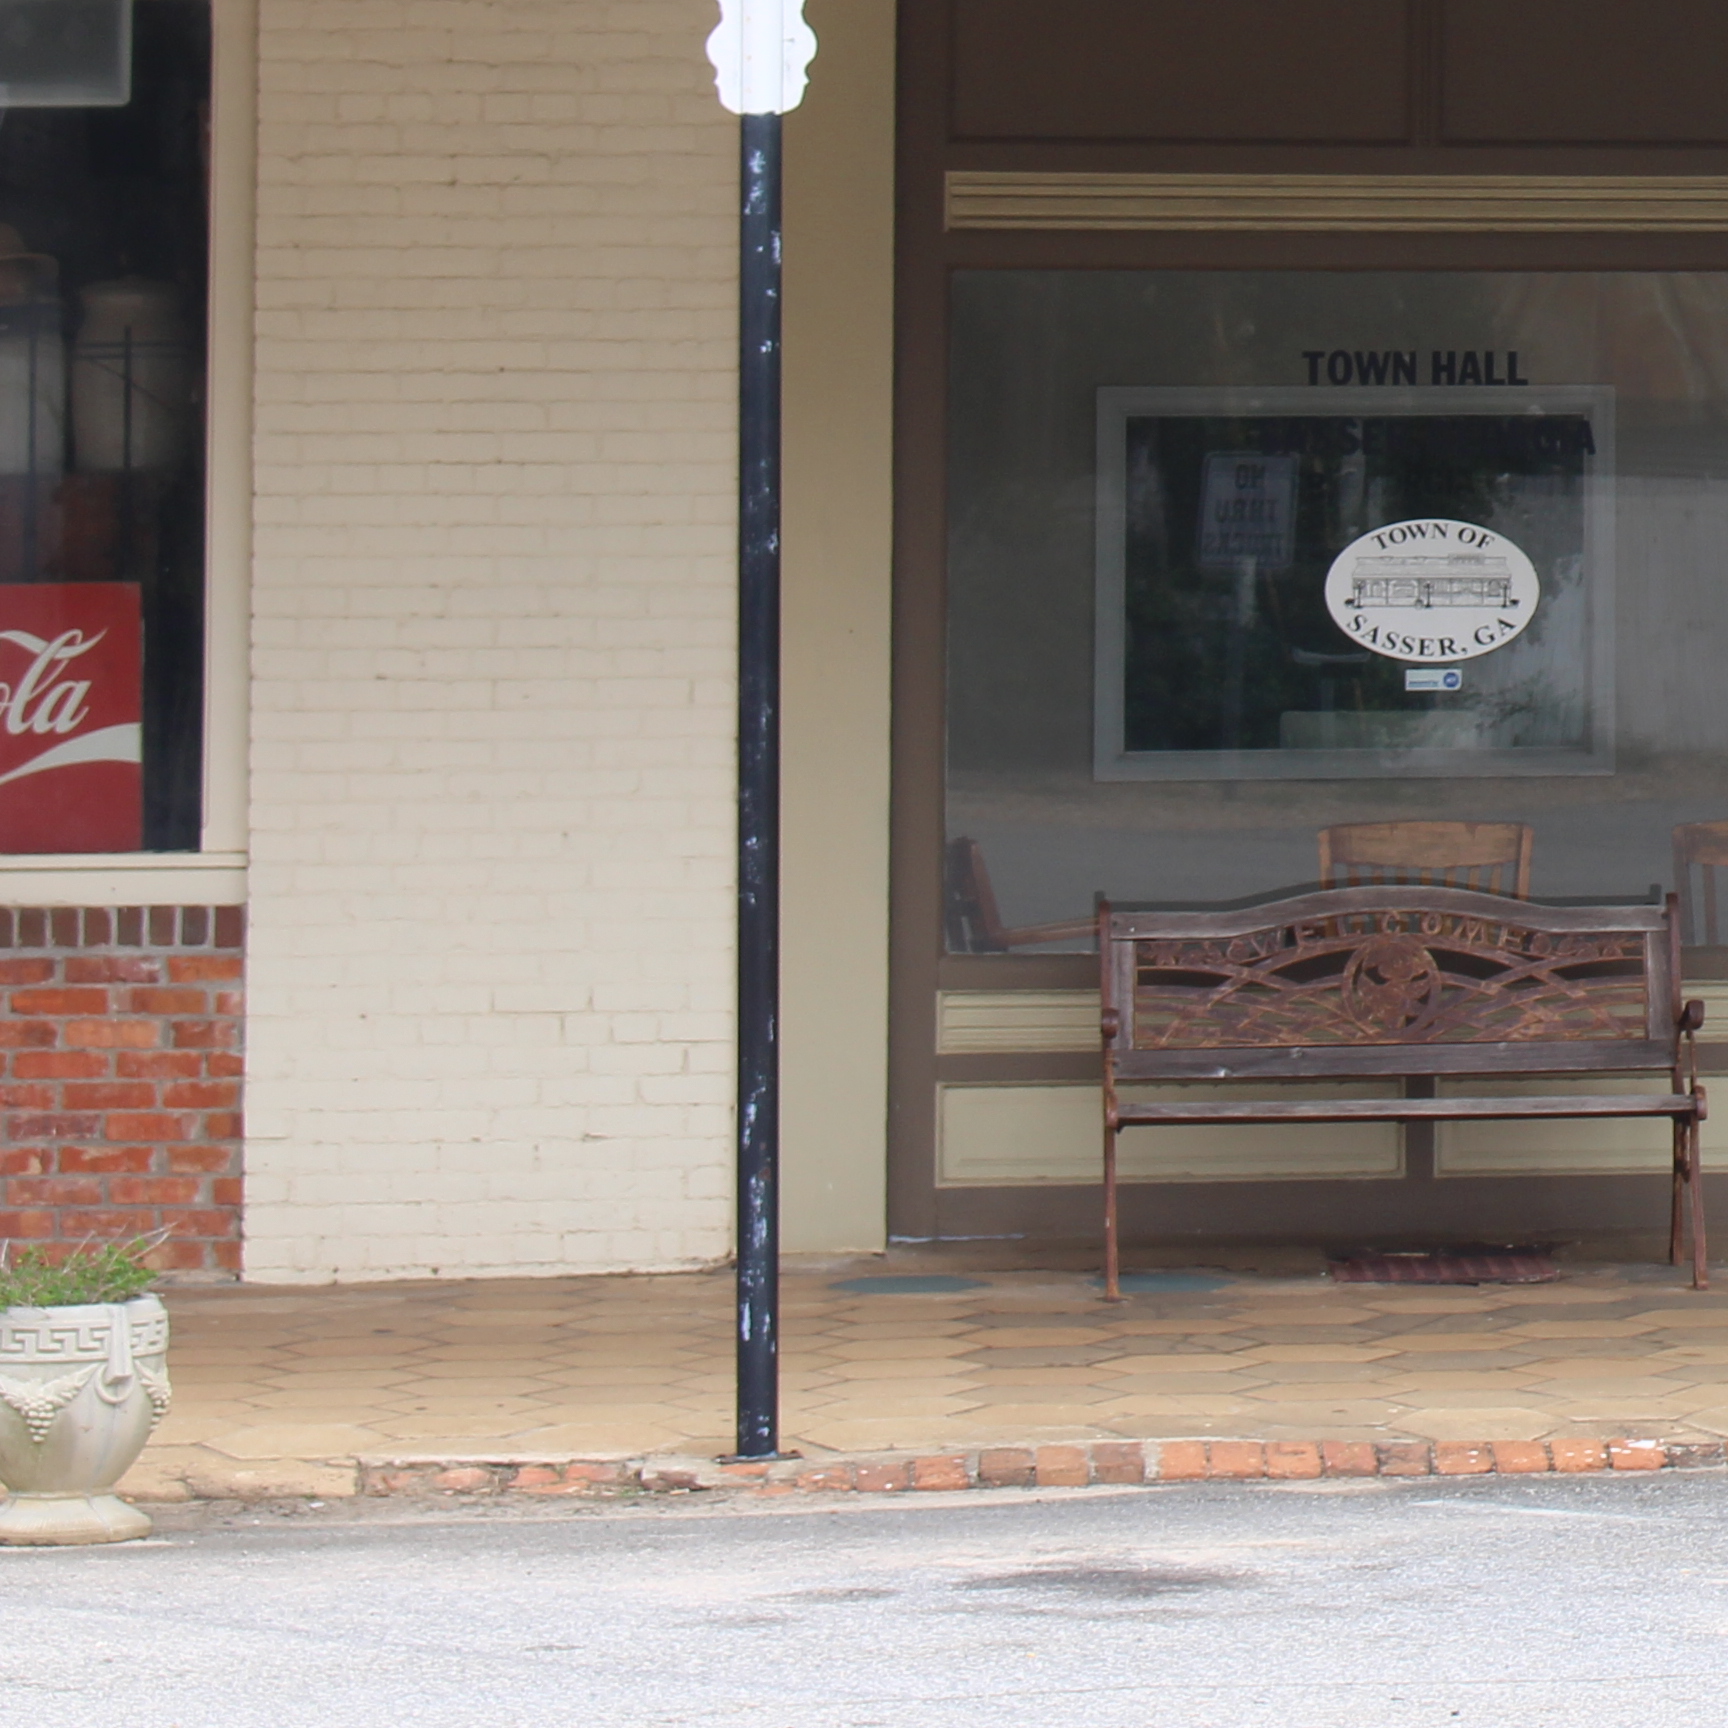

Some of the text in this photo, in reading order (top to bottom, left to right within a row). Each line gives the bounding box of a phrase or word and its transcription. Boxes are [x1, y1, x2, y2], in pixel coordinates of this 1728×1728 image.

[1302, 350, 1529, 386] TOWN HALL
[1371, 522, 1496, 550] TOWN OF
[1348, 613, 1517, 657] SASSER, GA
